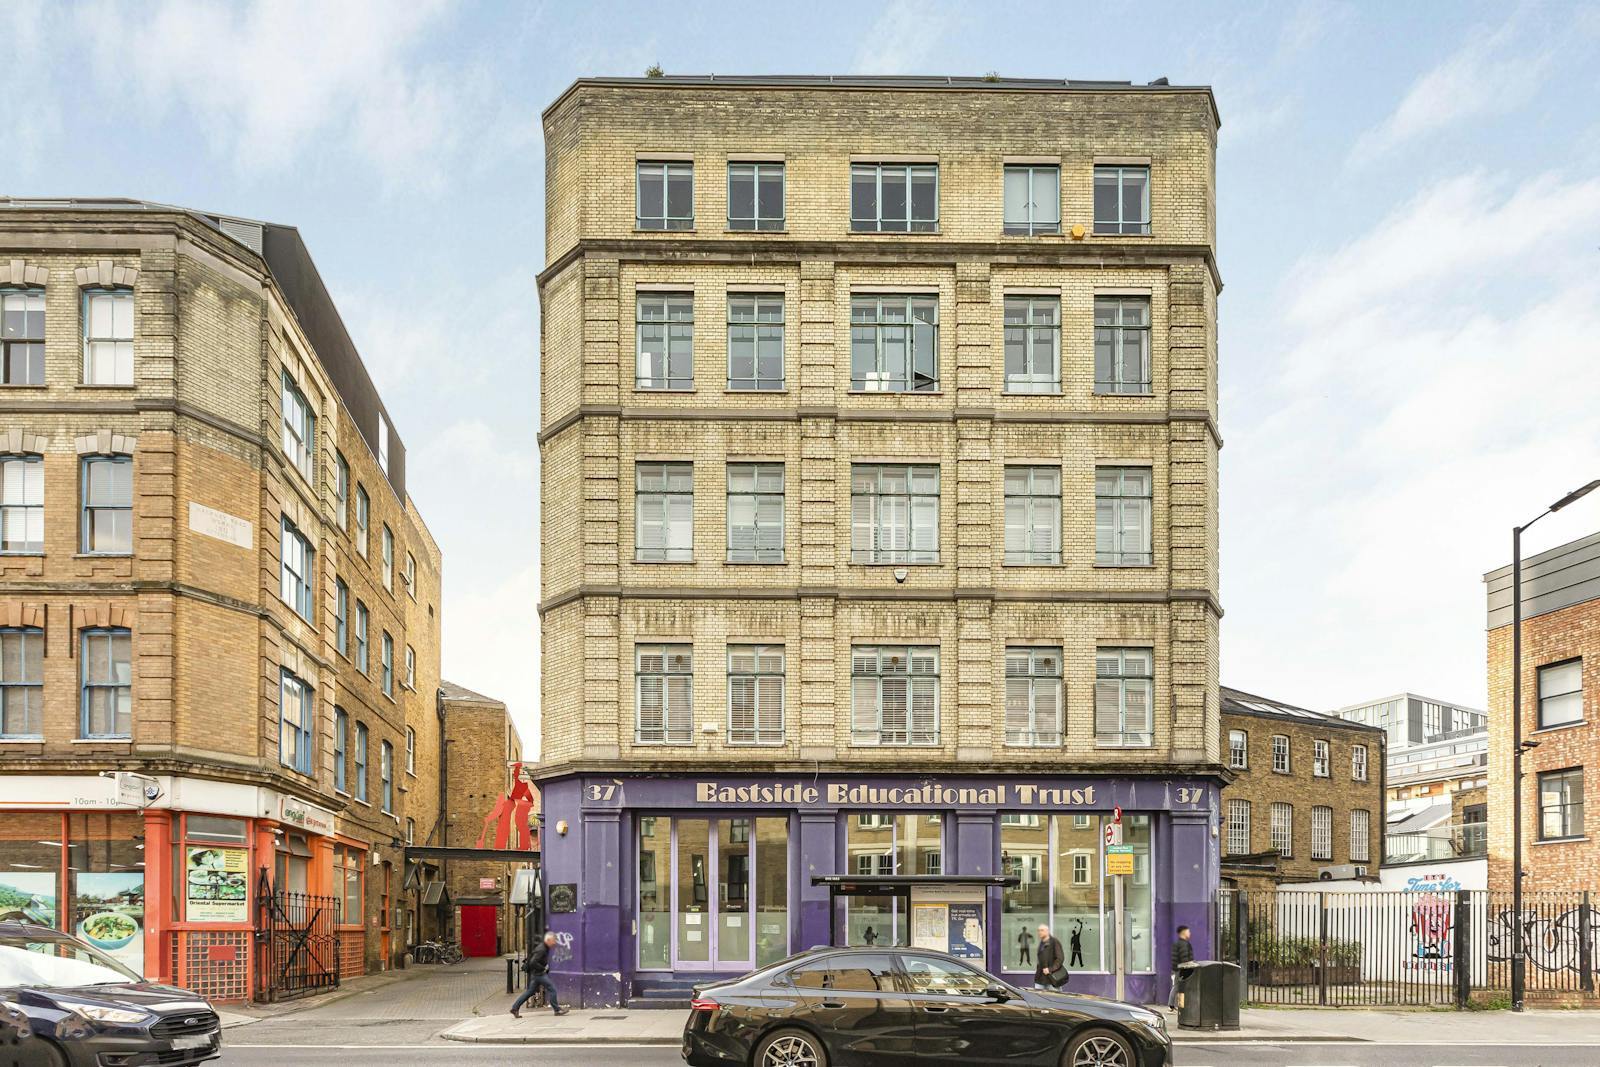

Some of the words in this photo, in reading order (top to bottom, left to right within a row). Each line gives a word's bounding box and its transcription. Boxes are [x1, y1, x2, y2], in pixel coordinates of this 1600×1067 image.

[585, 784, 616, 801] 37
[696, 782, 819, 804] Eastside
[827, 783, 1006, 805] Educational
[1015, 784, 1097, 805] Trust
[1175, 787, 1204, 803] 37
[105, 798, 120, 806] 10p
[1403, 877, 1437, 893] Time
